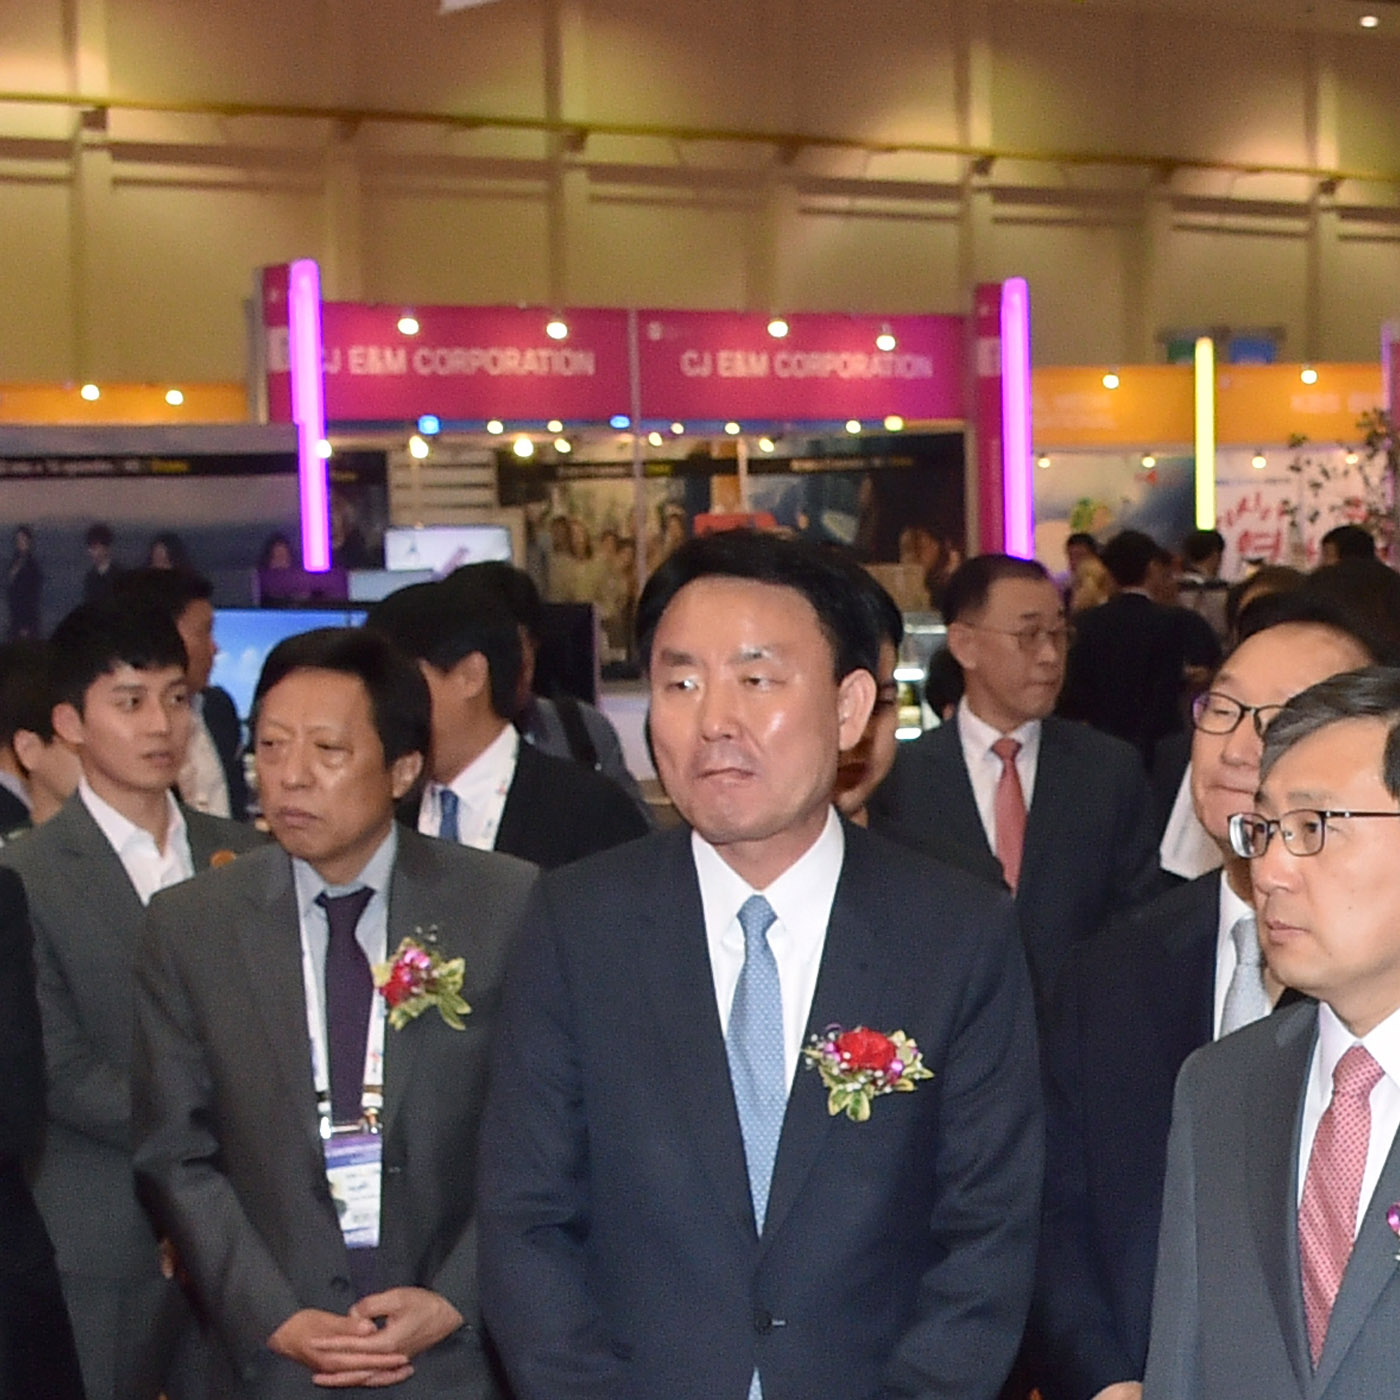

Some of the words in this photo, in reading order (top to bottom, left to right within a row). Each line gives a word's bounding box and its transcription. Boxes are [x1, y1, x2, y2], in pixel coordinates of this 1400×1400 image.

[350, 345, 407, 375] E&M
[412, 347, 596, 377] CORPORATION
[679, 348, 712, 378] CJ
[773, 350, 934, 379] CORPORATION
